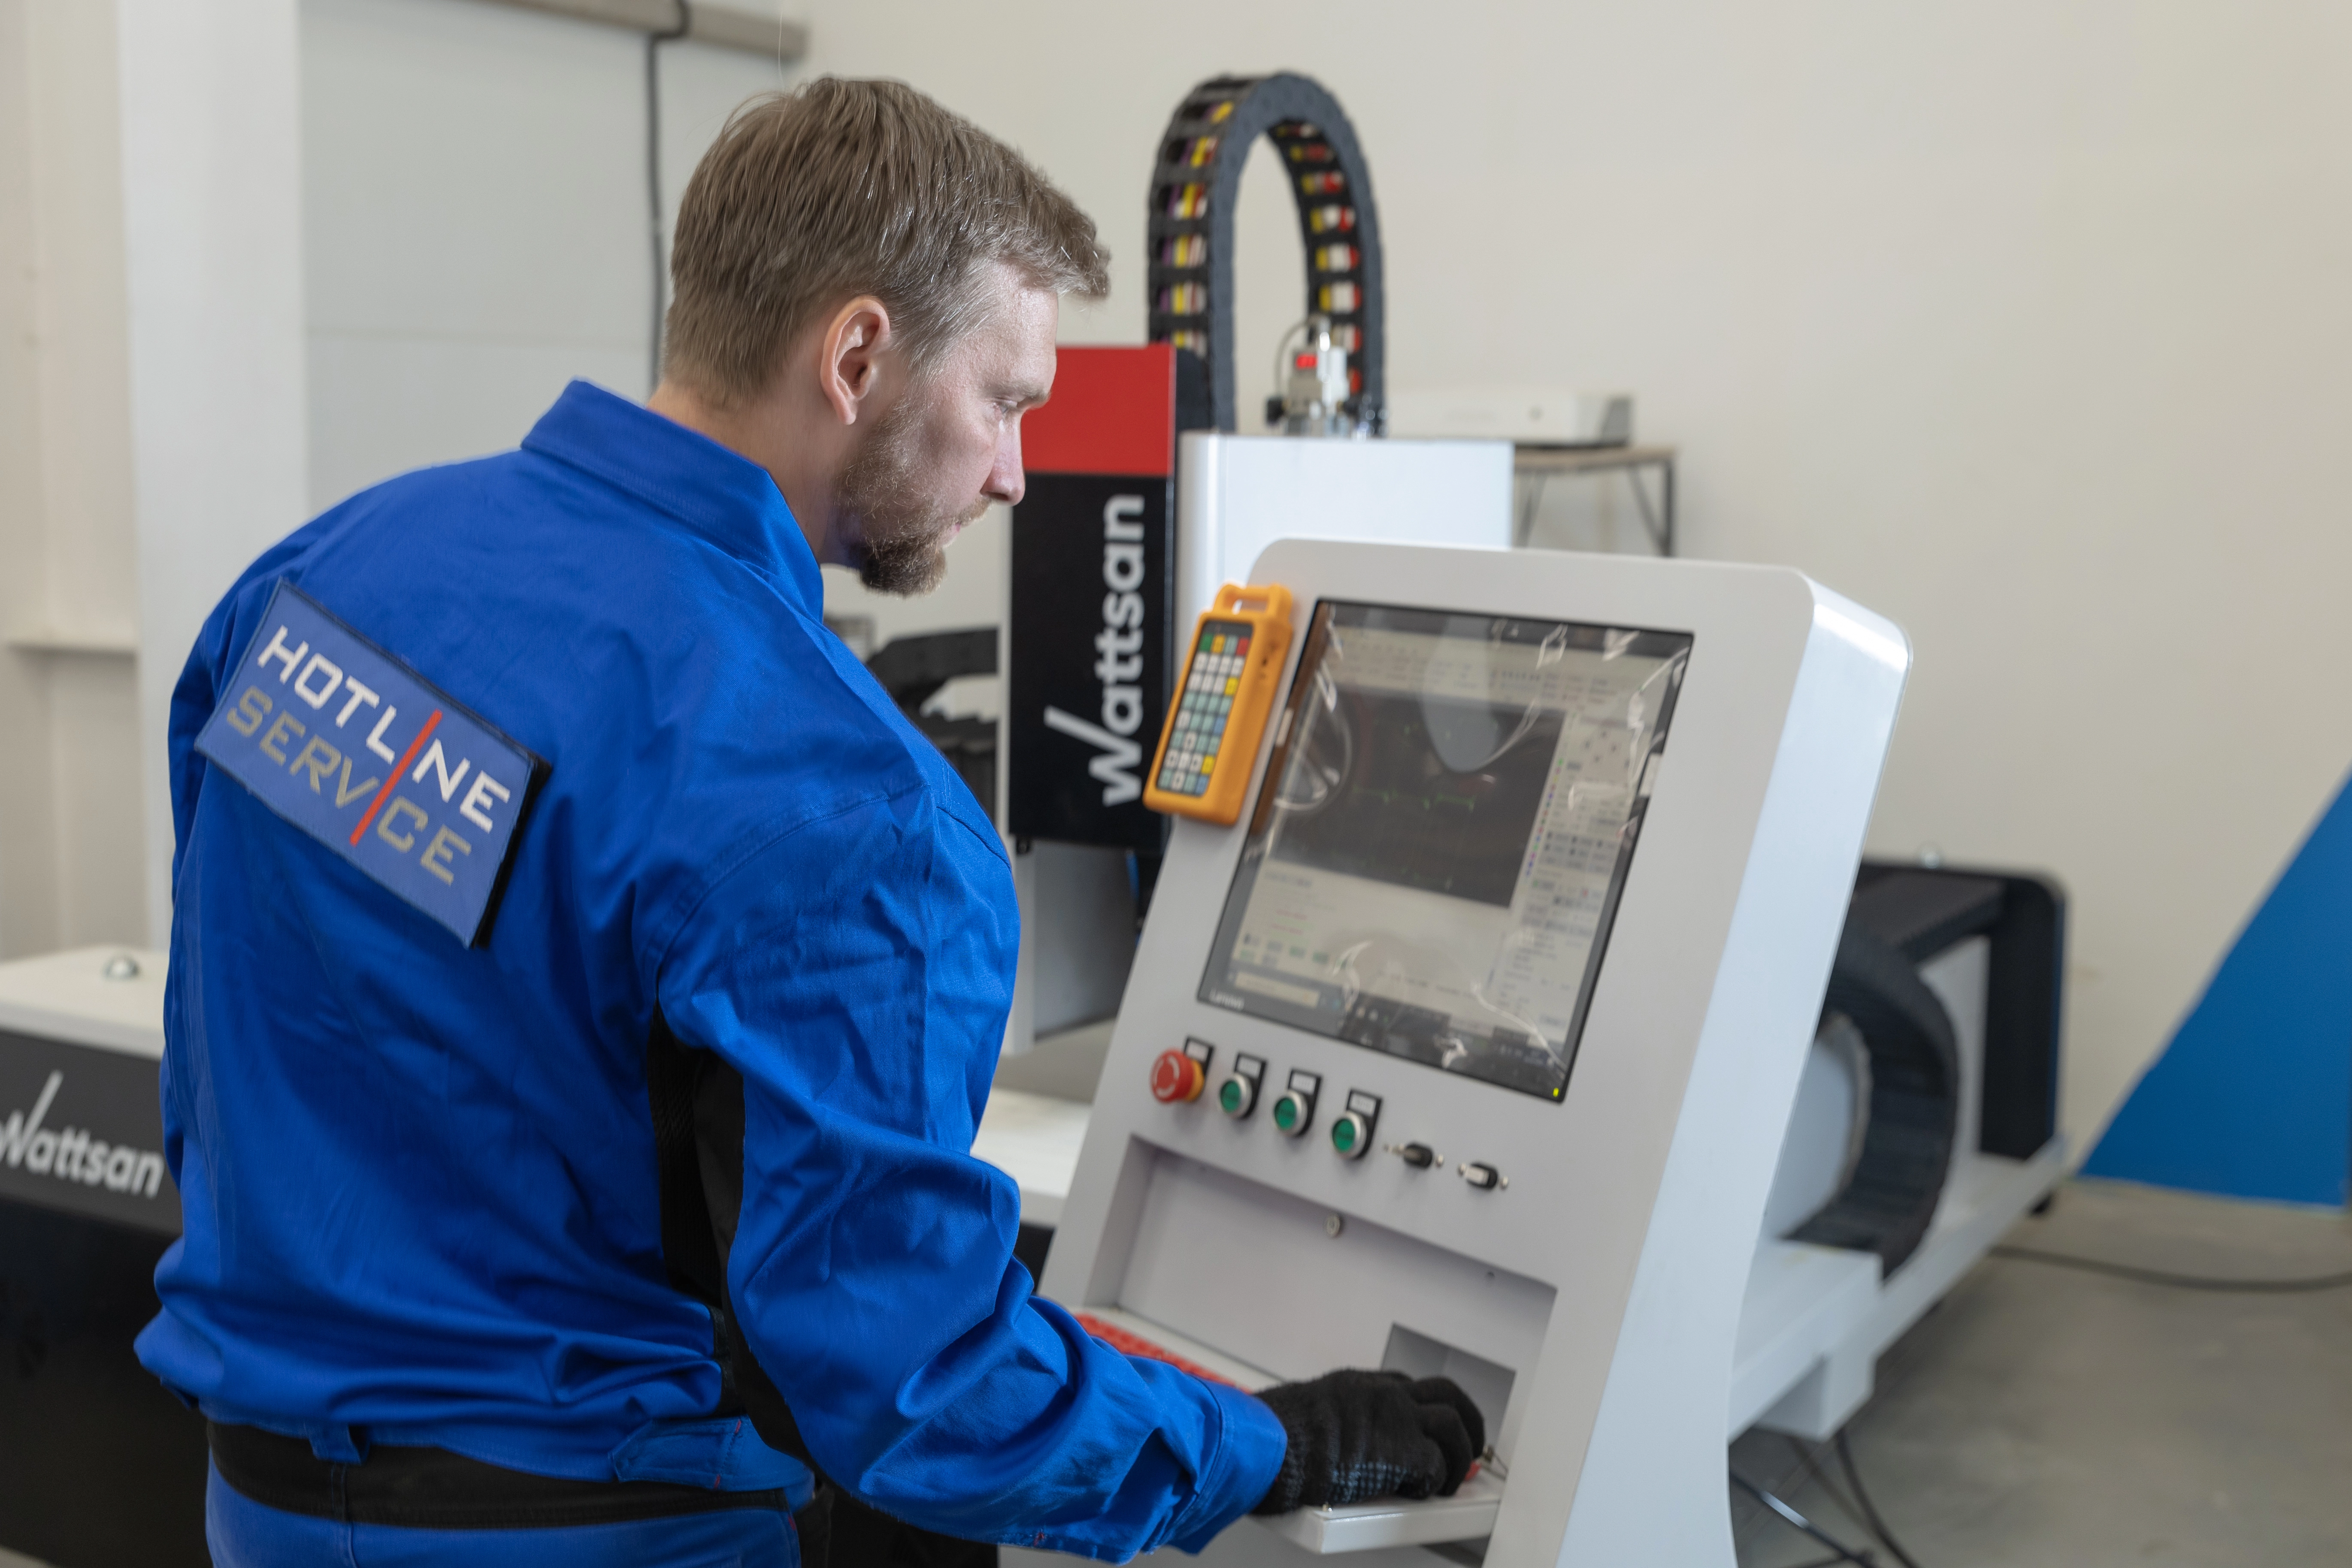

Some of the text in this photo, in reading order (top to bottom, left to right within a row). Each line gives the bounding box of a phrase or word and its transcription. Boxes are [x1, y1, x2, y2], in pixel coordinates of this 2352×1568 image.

[257, 625, 510, 833] HOTLINE
[1044, 493, 1145, 807] Wattsan
[227, 685, 472, 887] SERVICE
